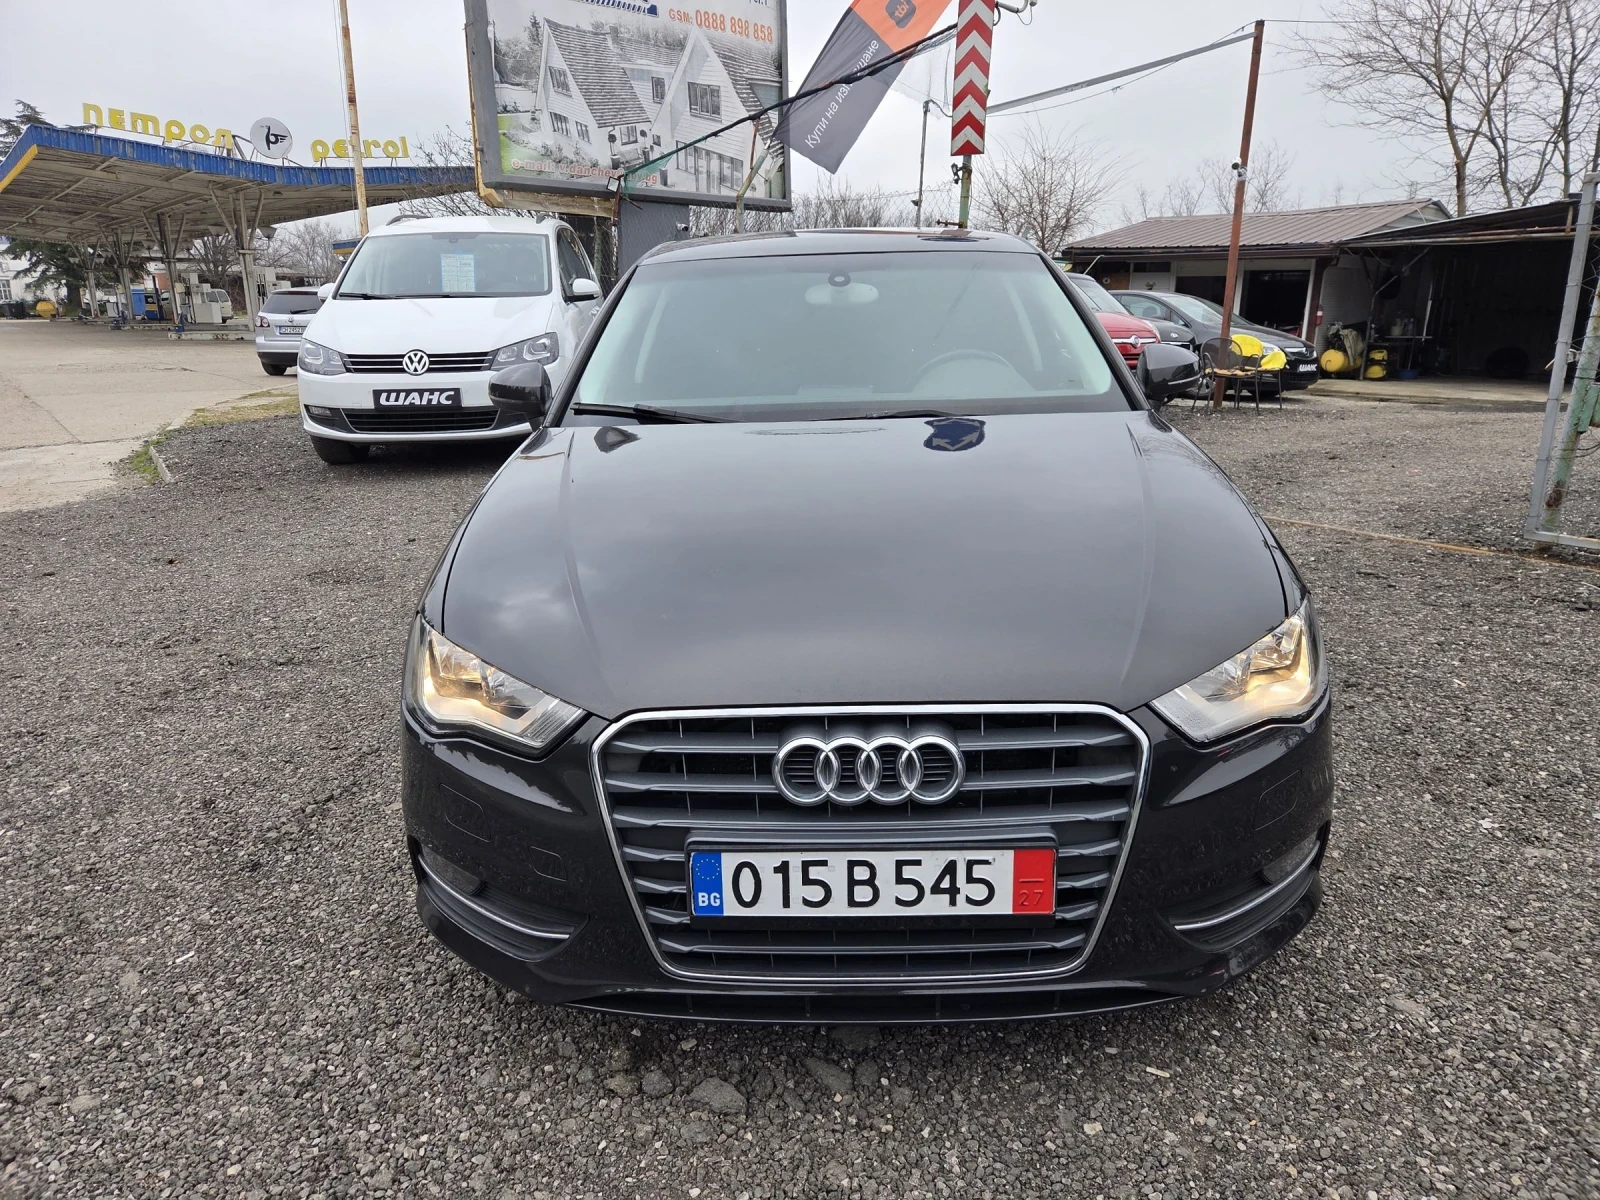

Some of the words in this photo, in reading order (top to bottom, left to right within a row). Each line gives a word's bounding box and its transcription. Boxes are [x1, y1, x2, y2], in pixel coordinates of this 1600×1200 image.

[894, 1, 910, 18] tbi
[668, 8, 693, 25] GSM:
[695, 9, 726, 32] 0888
[730, 16, 750, 38] 898
[753, 22, 773, 43] 858
[804, 117, 829, 149] Купи
[825, 101, 839, 119] на
[512, 159, 555, 173] e-mail:
[379, 391, 455, 405] ШАНС
[698, 892, 721, 907] BG
[1019, 889, 1045, 907] 27
